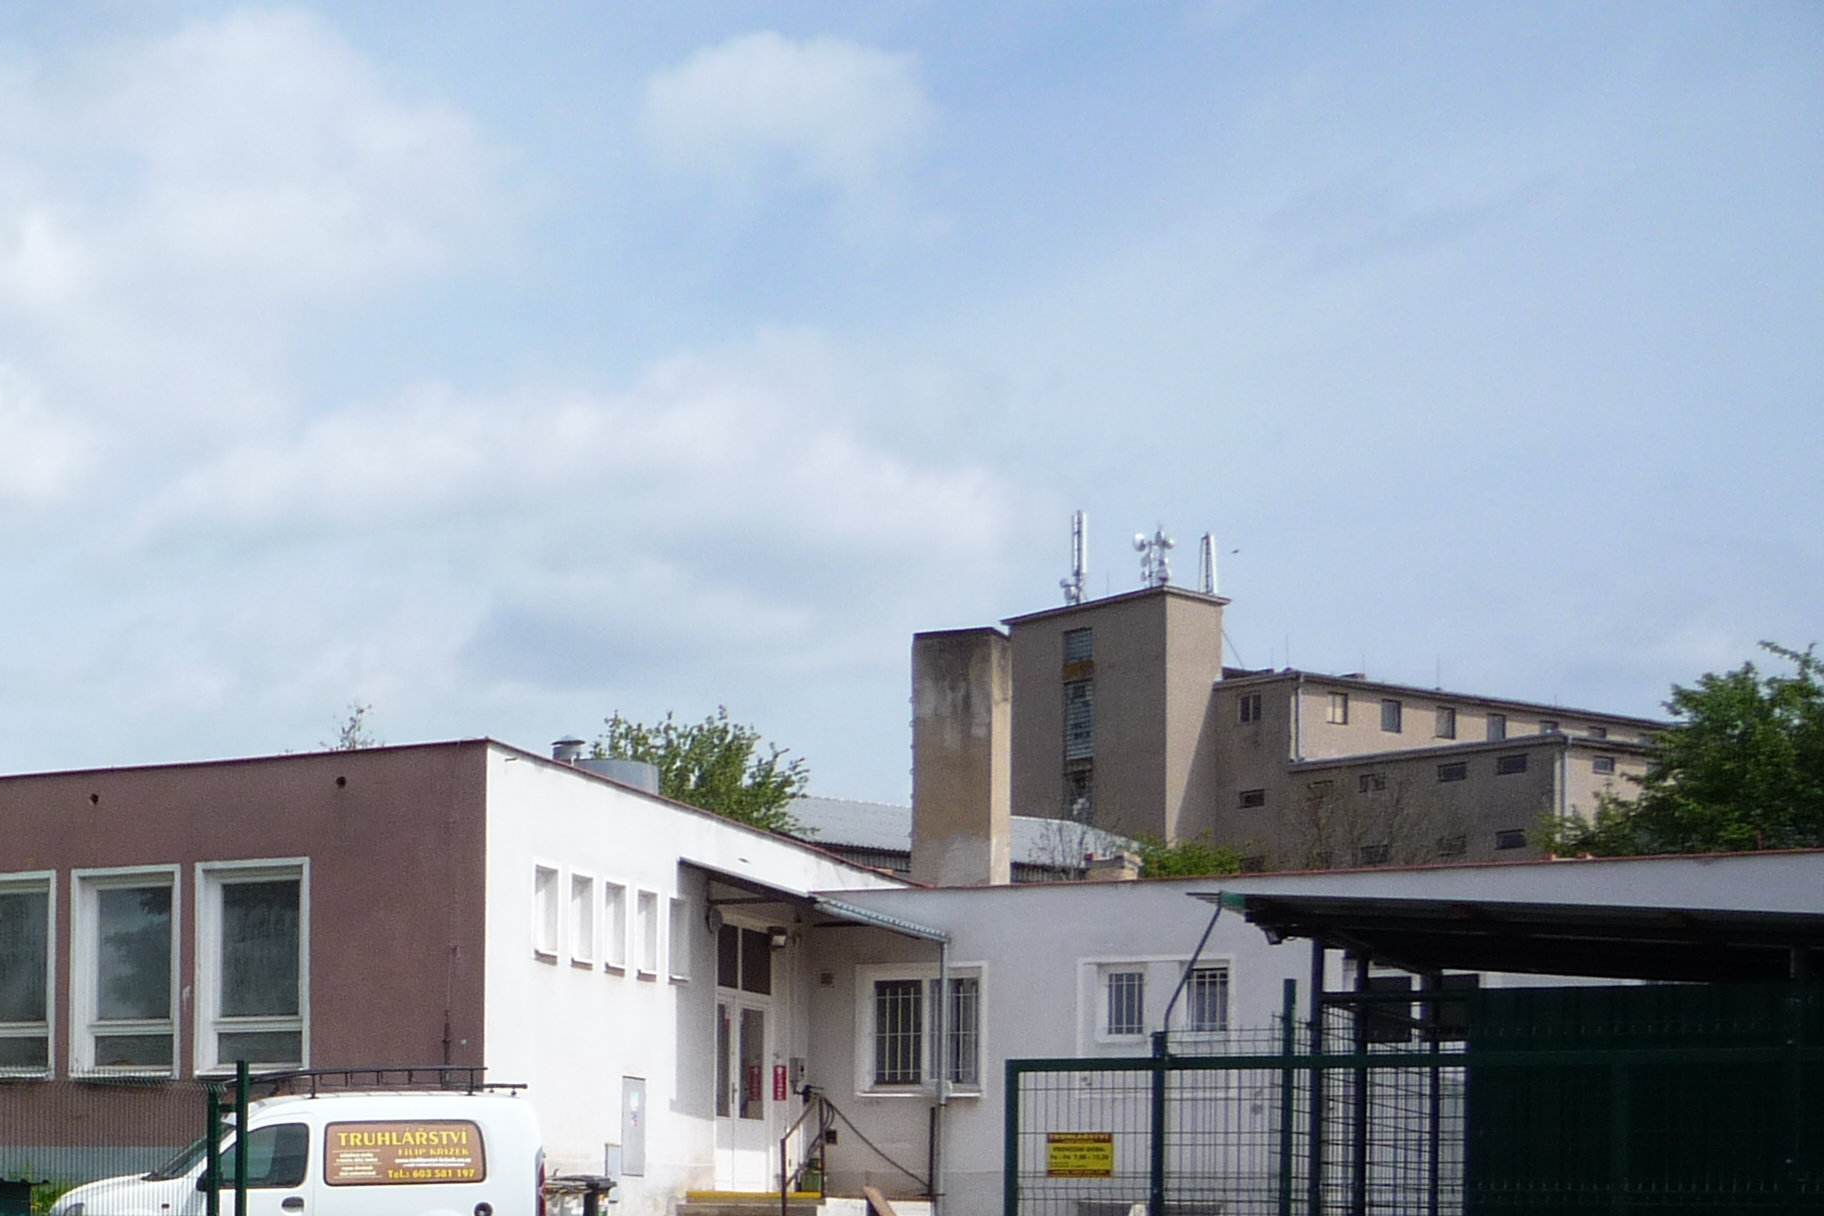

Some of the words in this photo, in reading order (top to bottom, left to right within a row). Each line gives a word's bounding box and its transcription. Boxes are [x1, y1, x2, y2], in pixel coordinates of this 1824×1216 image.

[337, 1127, 468, 1147] TRUHLÁŘSTVÍ
[412, 1169, 432, 1179] 603
[434, 1168, 453, 1178] 581
[457, 1168, 476, 1178] 197
